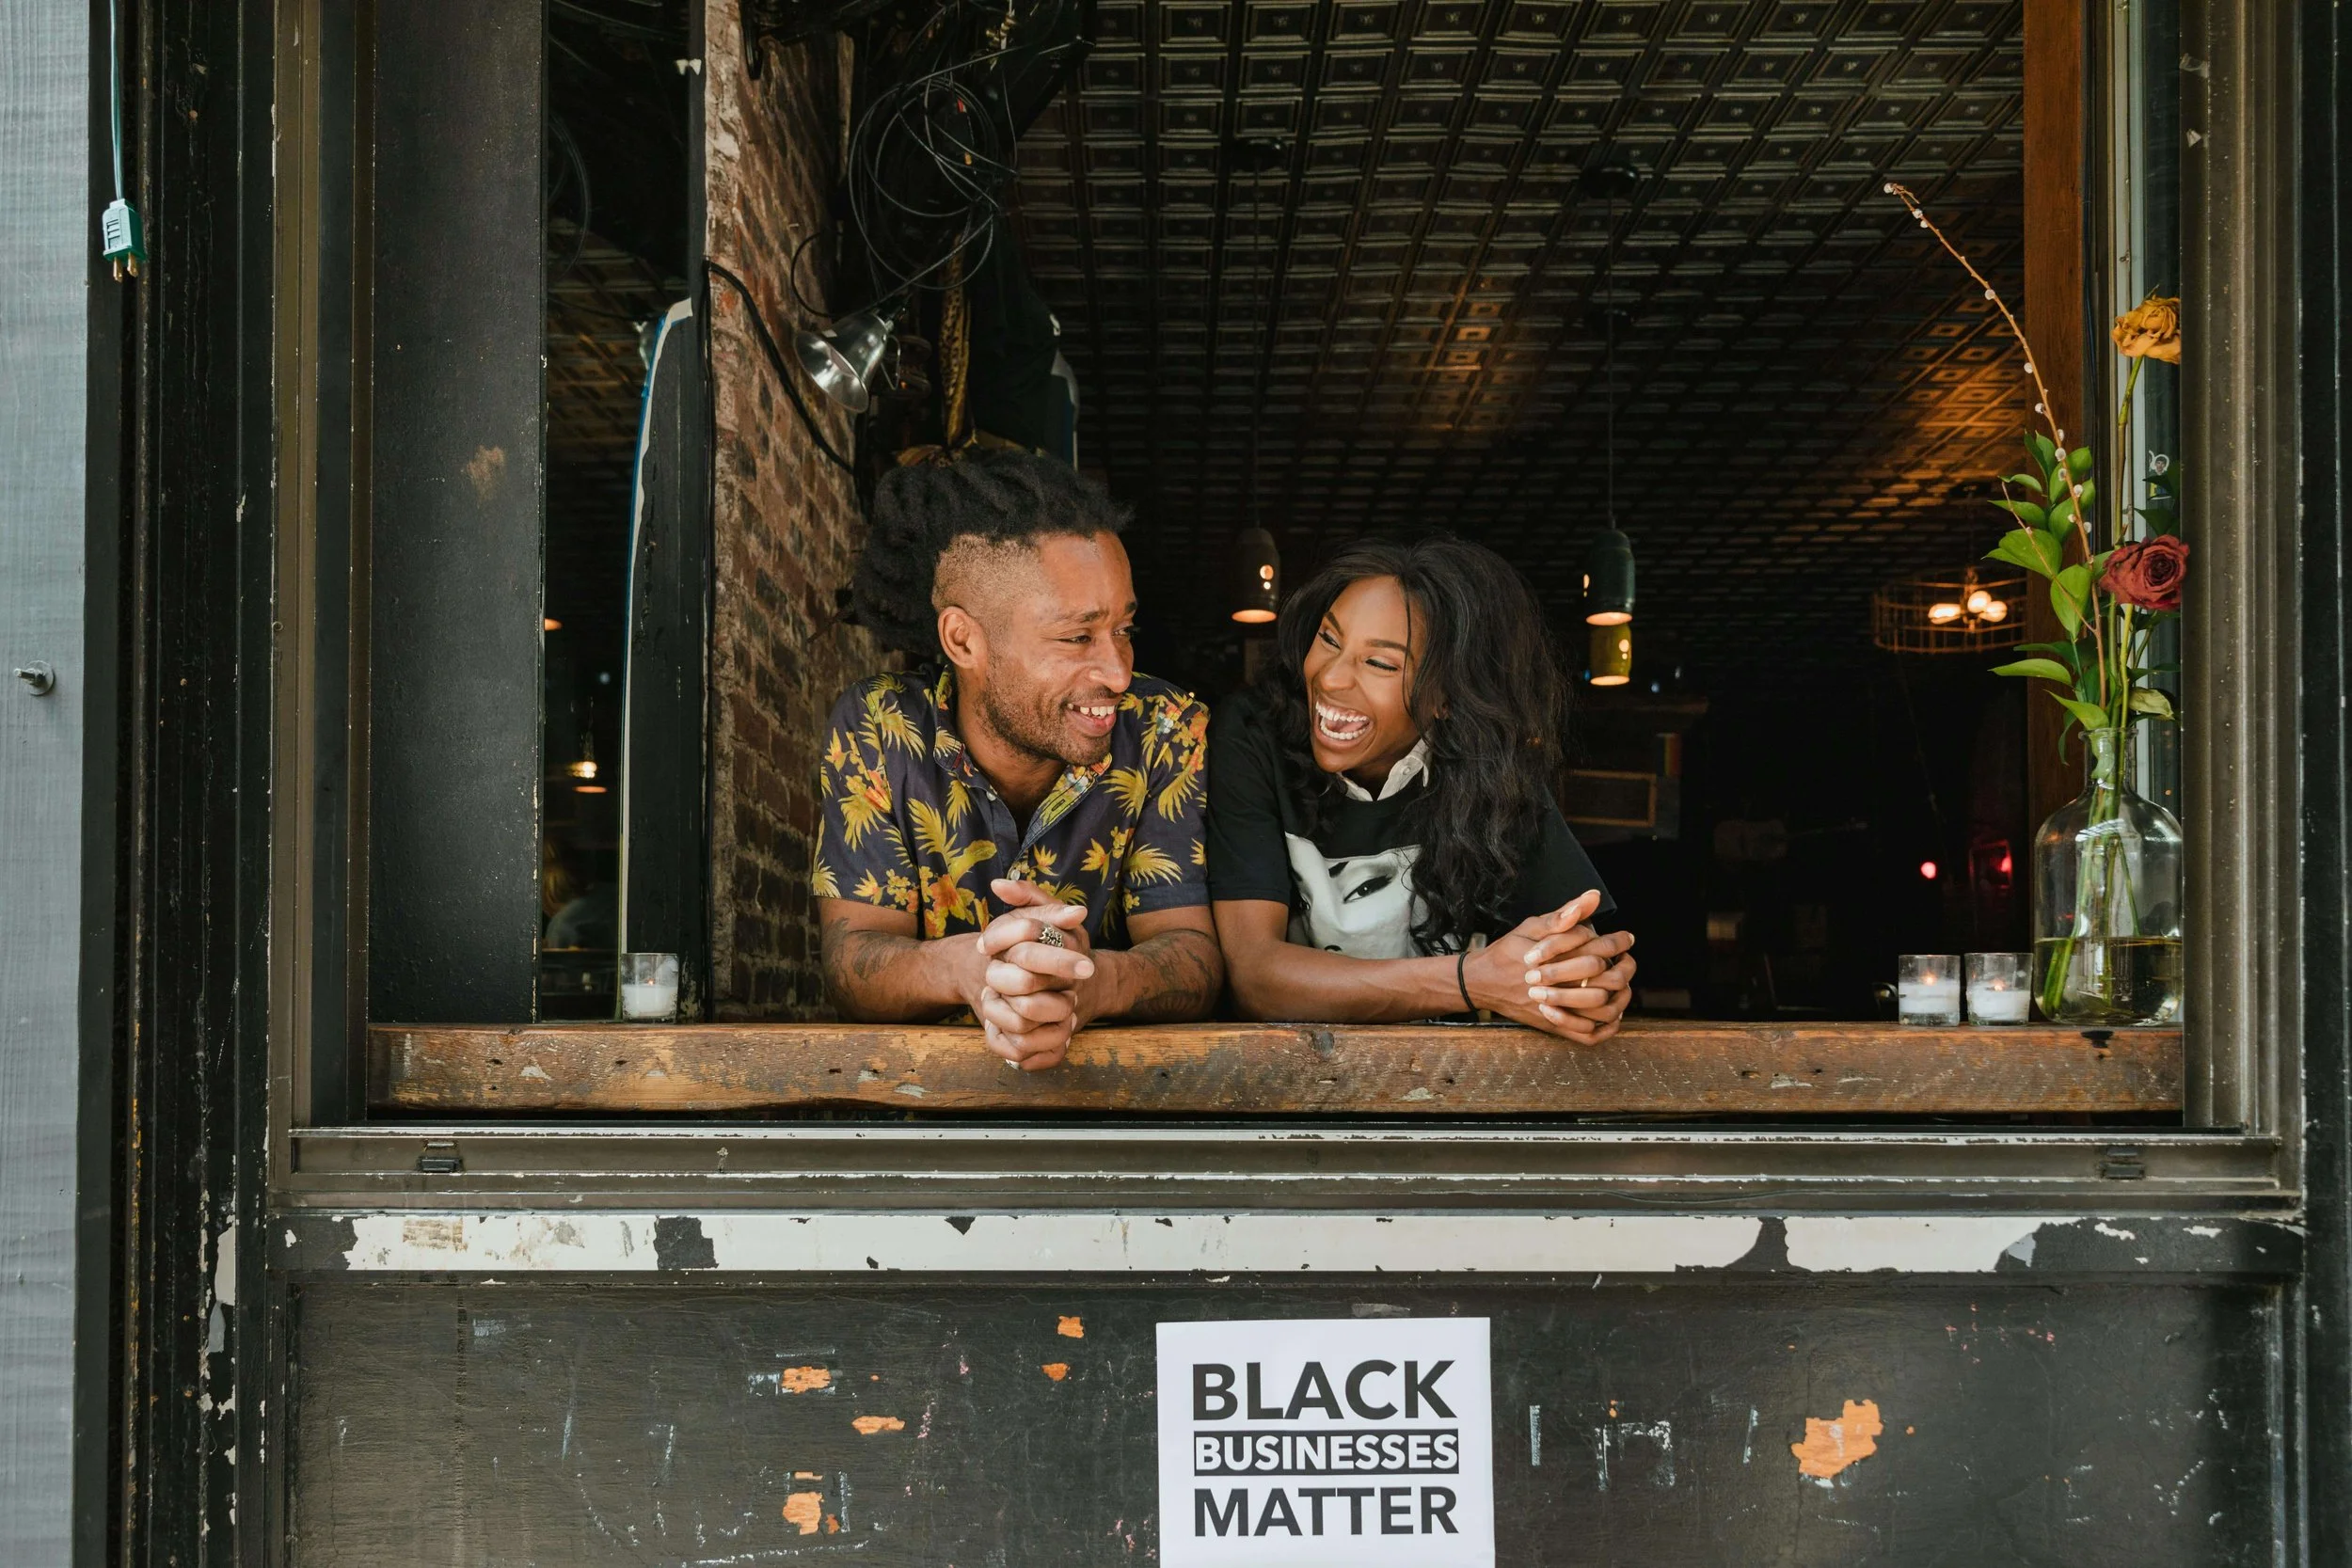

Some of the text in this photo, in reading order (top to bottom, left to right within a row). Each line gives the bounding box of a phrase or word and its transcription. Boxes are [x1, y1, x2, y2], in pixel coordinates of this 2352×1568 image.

[1193, 1359, 1456, 1420] BLACK
[1196, 1434, 1456, 1471] BUSINESSES
[1194, 1486, 1459, 1537] MATTER
